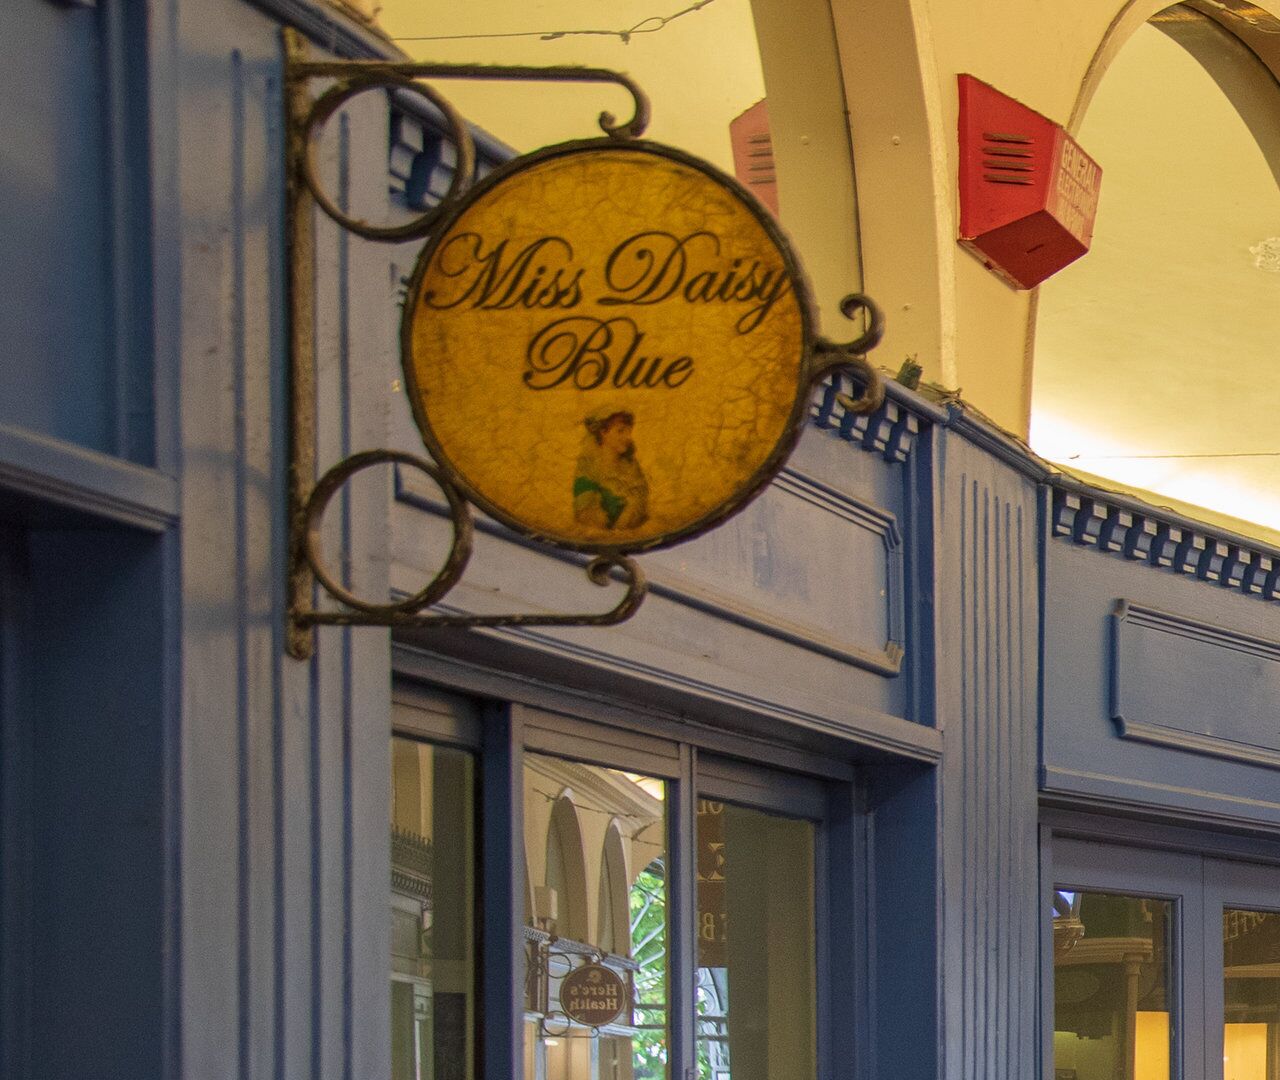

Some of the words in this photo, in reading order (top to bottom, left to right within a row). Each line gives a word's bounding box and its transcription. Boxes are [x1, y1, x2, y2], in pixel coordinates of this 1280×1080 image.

[424, 231, 585, 311] Miss
[595, 230, 800, 336] Daisy
[521, 315, 696, 392] Blue
